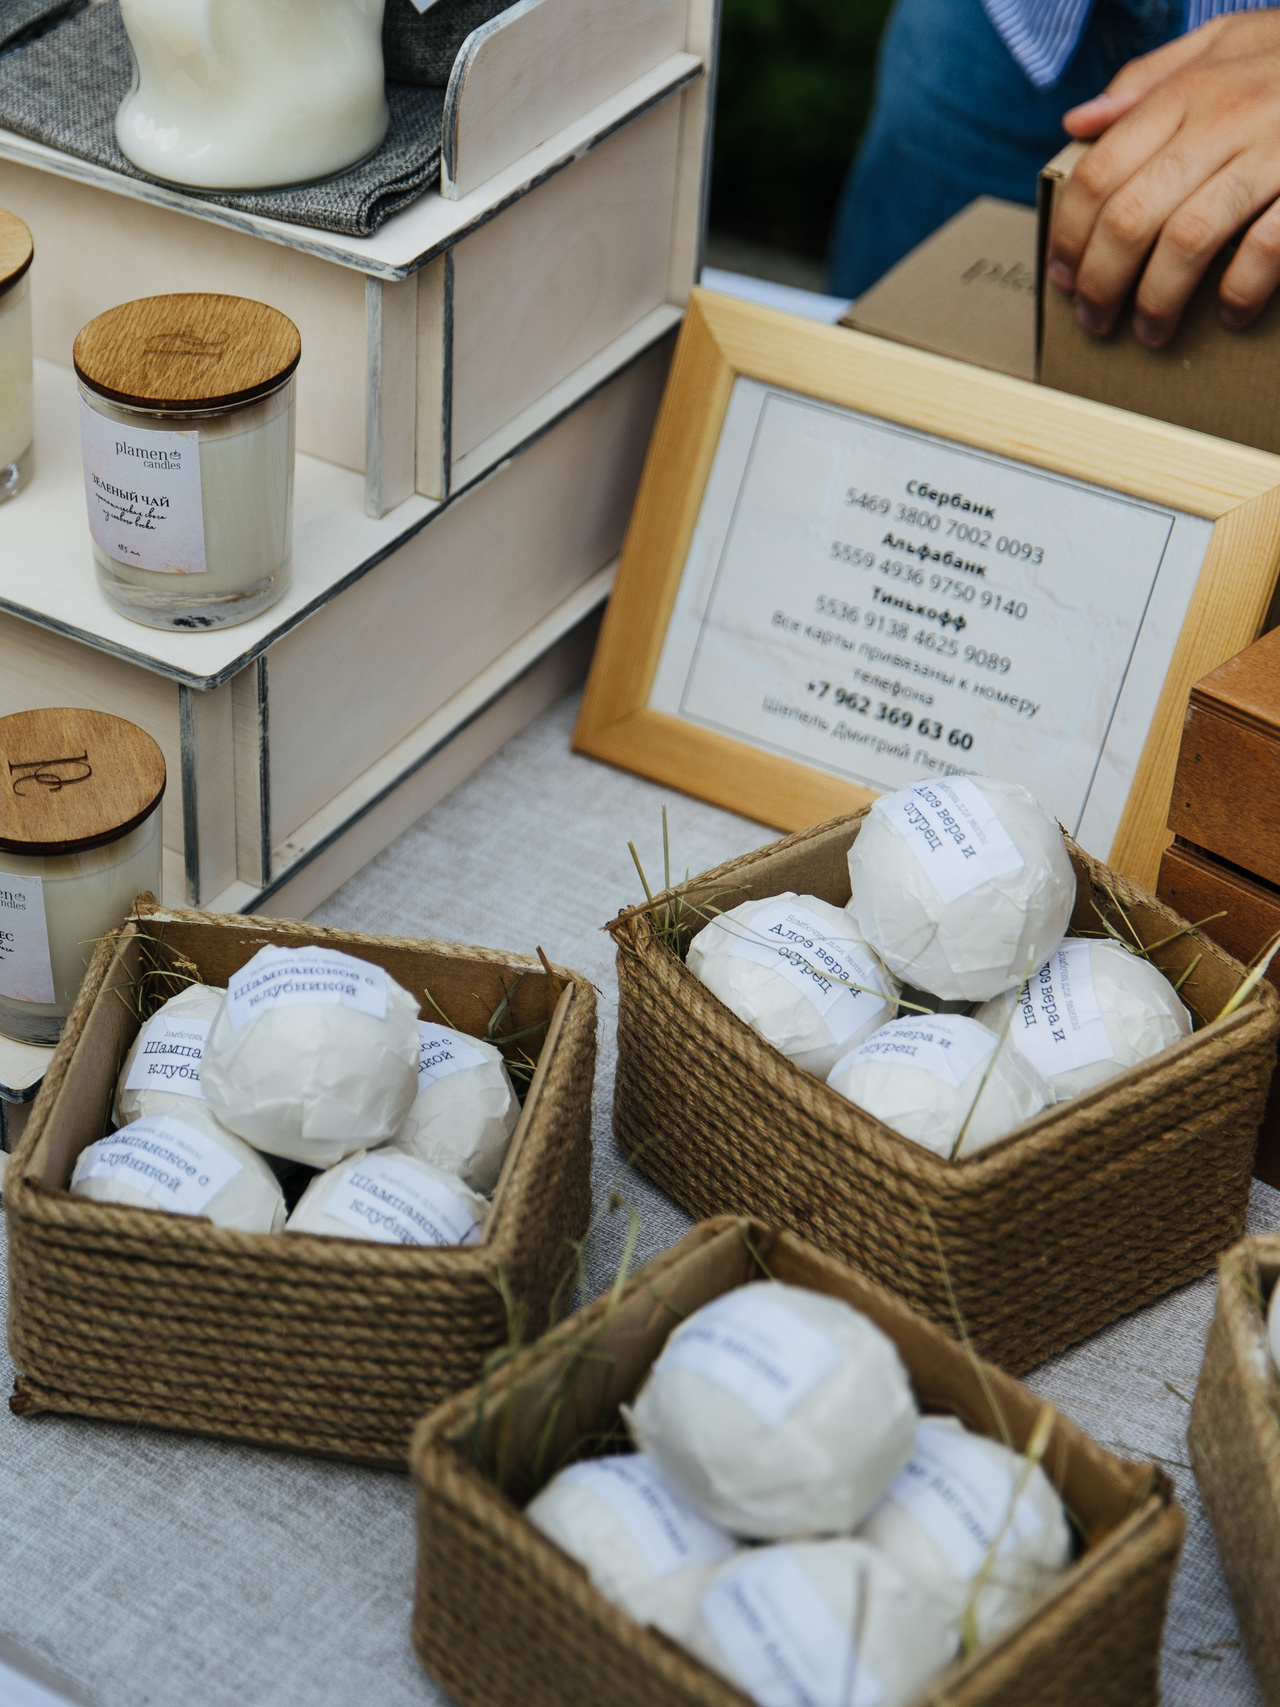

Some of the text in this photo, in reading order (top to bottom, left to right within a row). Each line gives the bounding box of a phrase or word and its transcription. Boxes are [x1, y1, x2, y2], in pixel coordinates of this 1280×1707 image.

[115, 441, 169, 461] plamen
[143, 459, 182, 470] candles
[92, 473, 170, 508] ЗЕЛЕНЫЙ ЧАЙ
[906, 479, 997, 519] Сбербанк
[845, 487, 1045, 565] 5469 3800 7002 0093
[881, 531, 988, 577] Альфабанк
[830, 540, 1029, 620] 5559 4936 9750 9140
[872, 585, 968, 632] Тинькофф
[816, 594, 1012, 676] 5536 9138 4625 9089
[772, 609, 1041, 718] Все карты привязаны к номеру
[852, 667, 935, 707] телефона
[806, 680, 974, 751] +7 962 369 63 60
[830, 721, 913, 760] Дмитрий
[913, 749, 982, 780] Петро
[903, 802, 943, 852] огурец
[936, 808, 966, 844] вера
[961, 845, 977, 860] и
[768, 923, 814, 948] Алоэ
[814, 947, 849, 981] вера
[778, 946, 833, 995] огурец
[233, 966, 375, 1001] Шампанское с
[249, 979, 357, 1007] клубникой
[1041, 985, 1060, 1026] вера
[1052, 1028, 1066, 1043] и
[143, 1041, 203, 1059] Шампа
[442, 1038, 453, 1046] с
[859, 1042, 919, 1056] огурец
[893, 1030, 934, 1043] вера
[938, 1038, 952, 1049] и
[147, 1063, 200, 1081] клубн
[99, 1133, 210, 1187] Шампанское с
